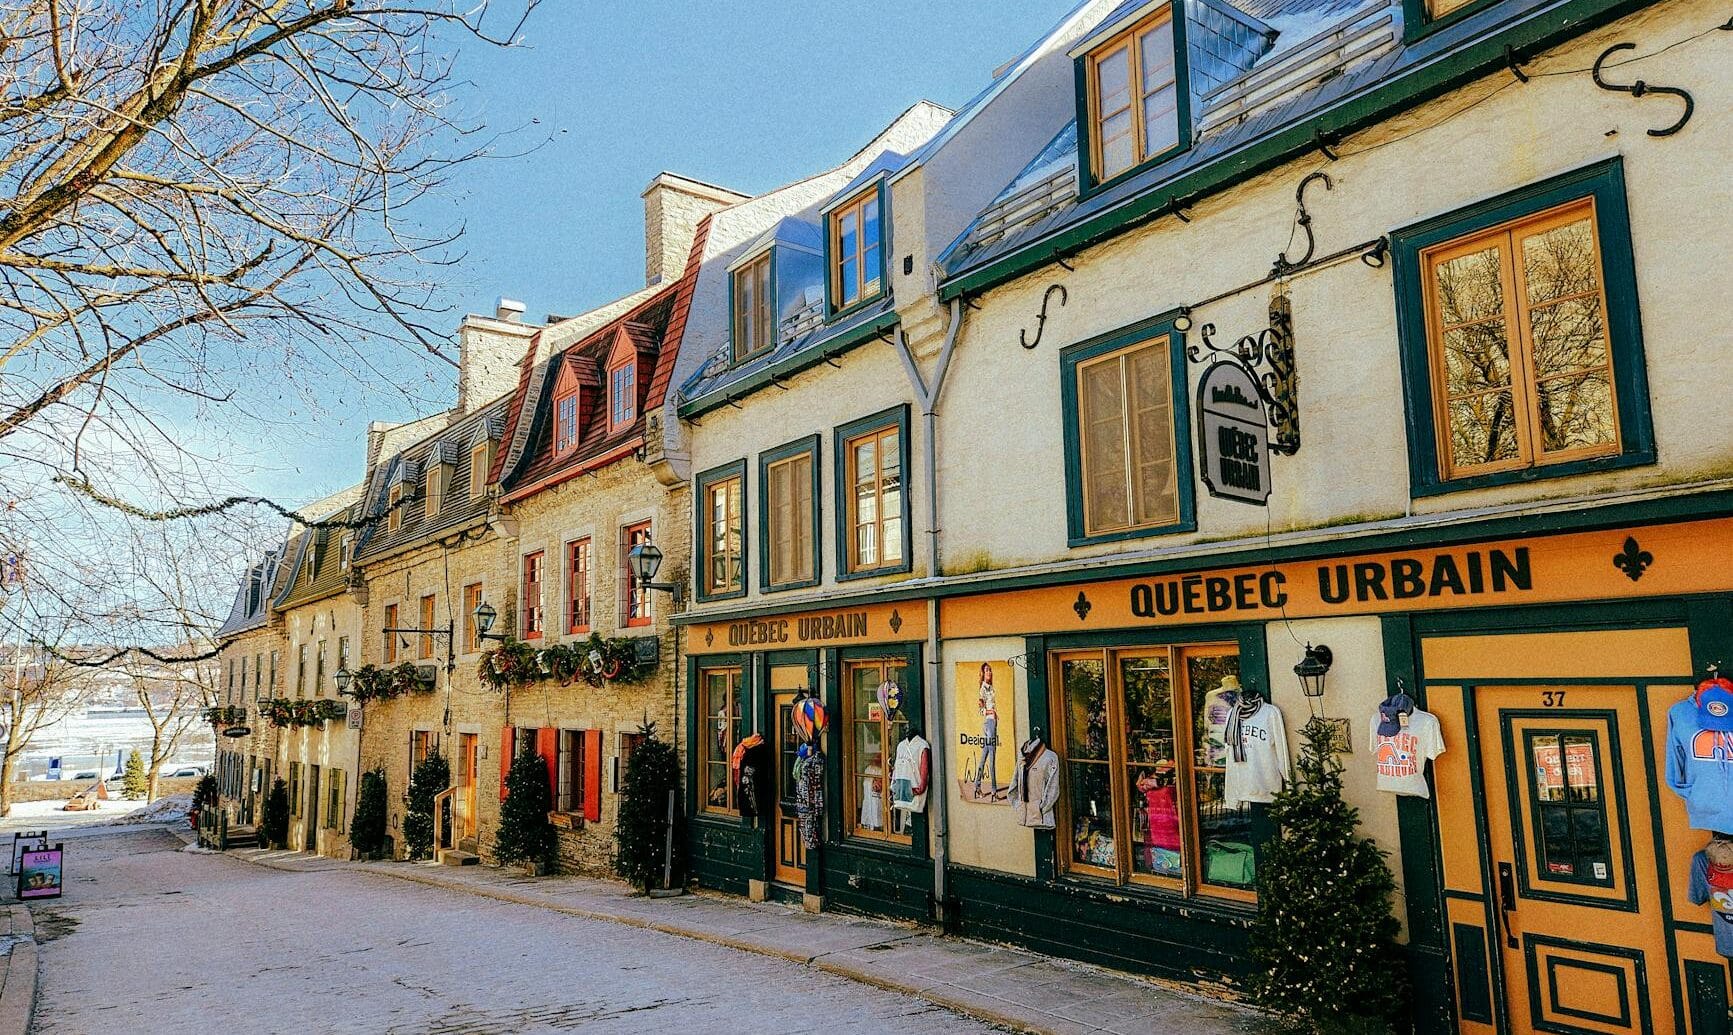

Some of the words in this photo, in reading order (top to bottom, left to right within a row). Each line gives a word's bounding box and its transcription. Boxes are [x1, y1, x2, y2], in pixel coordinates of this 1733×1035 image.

[1318, 546, 1533, 604] URBAIN
[798, 612, 868, 641] URBAIN
[1542, 691, 1566, 707] 37
[1545, 753, 1585, 767] OUERT
[1553, 766, 1583, 777] OEN
